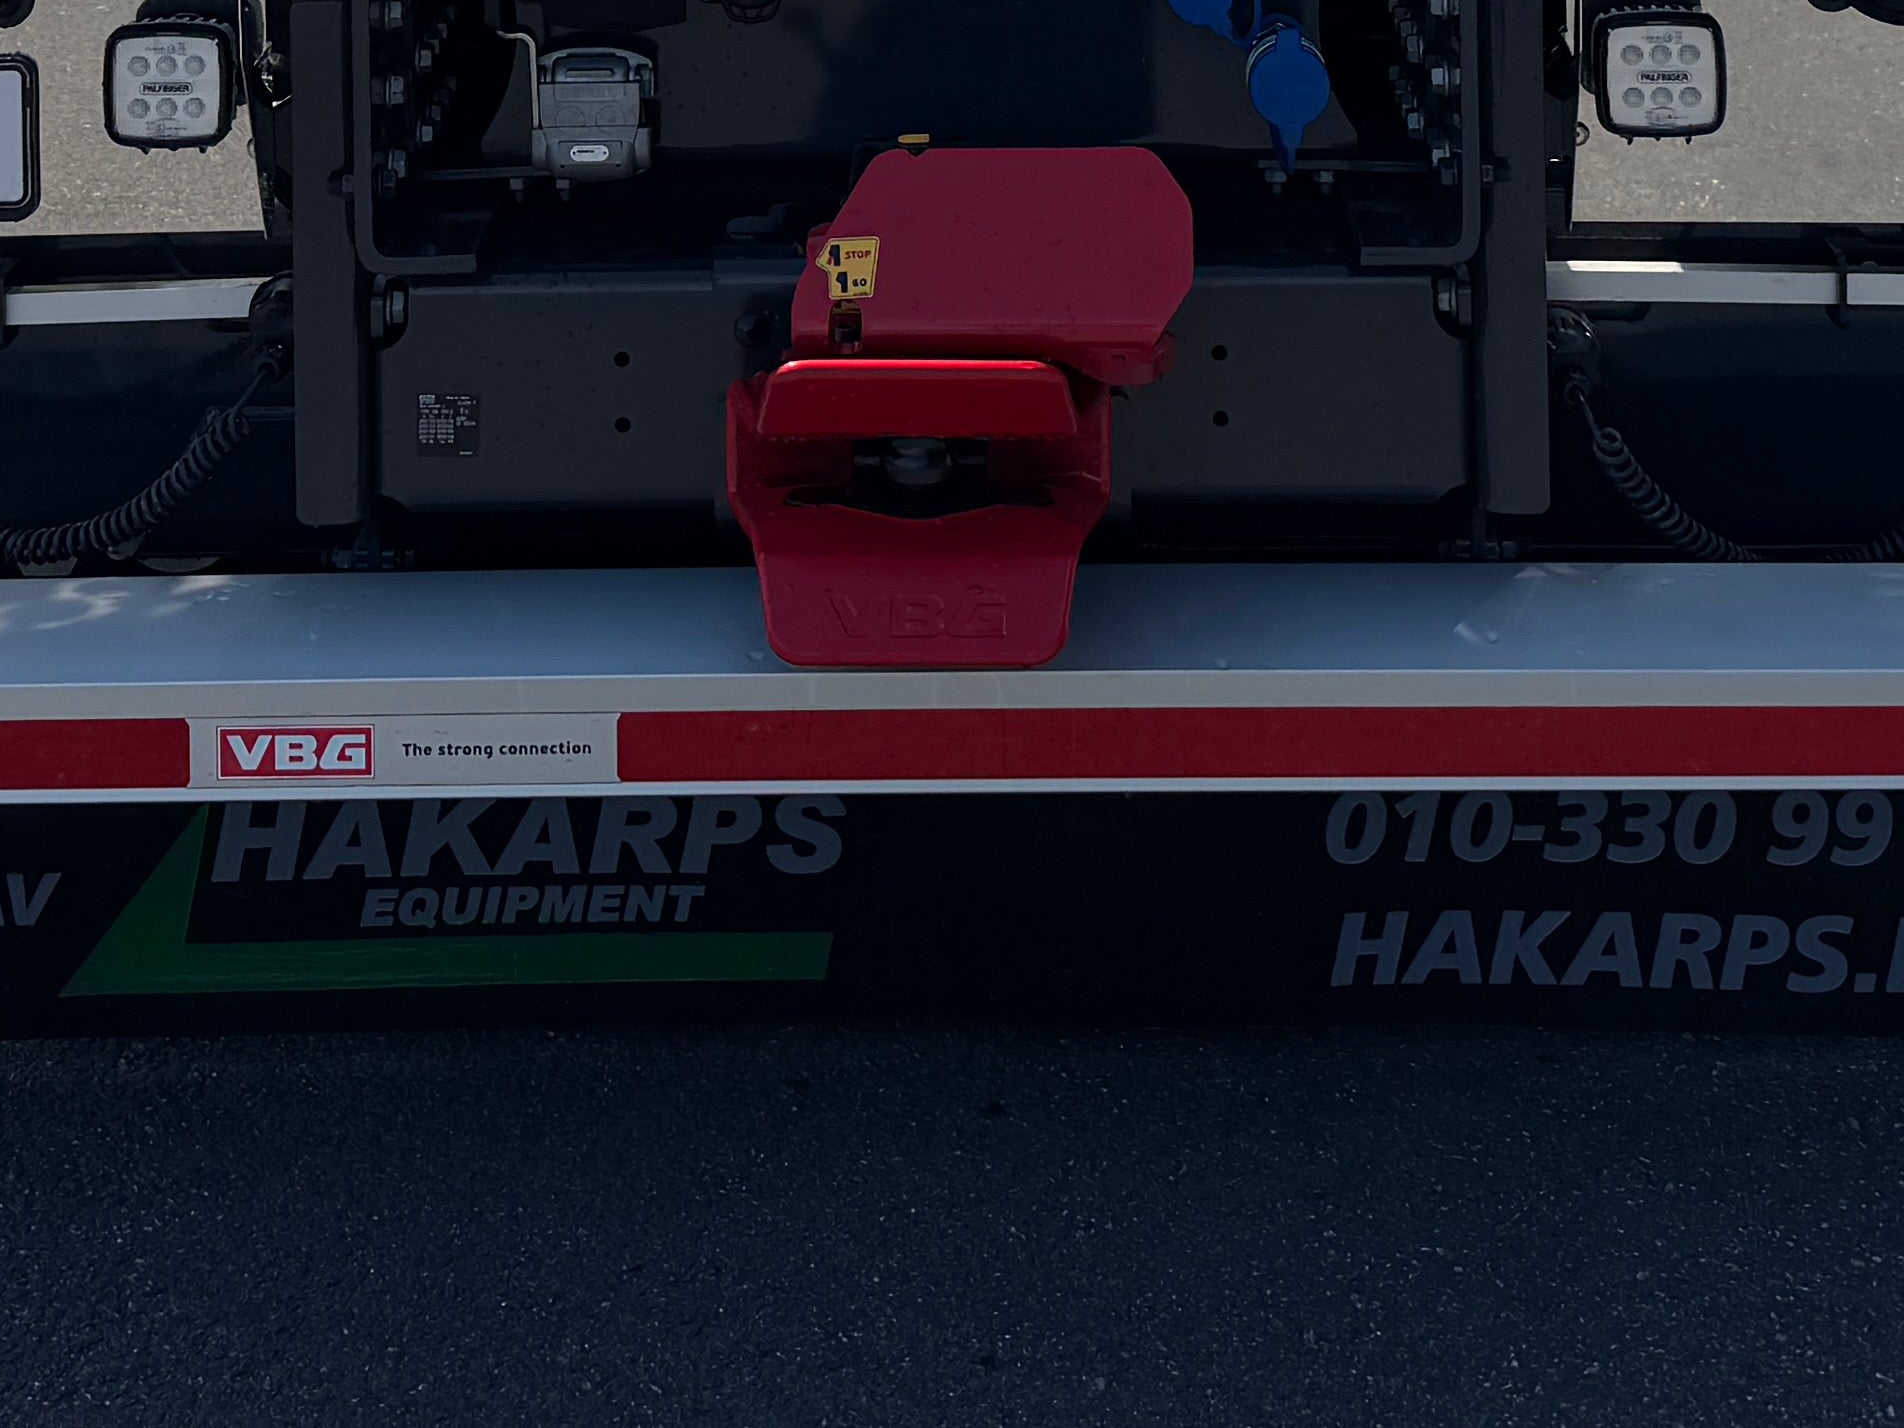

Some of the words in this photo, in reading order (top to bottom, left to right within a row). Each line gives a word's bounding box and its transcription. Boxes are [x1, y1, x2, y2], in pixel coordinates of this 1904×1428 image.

[844, 249, 872, 260] STOP
[851, 277, 867, 287] GO
[824, 593, 1007, 639] VBG
[225, 733, 367, 771] VBG
[402, 743, 432, 757] The
[437, 743, 493, 760] strong
[498, 740, 592, 756] connection
[210, 796, 848, 883] HAKARPS
[1325, 792, 1739, 866] 010-330
[1765, 792, 1895, 867] 99
[359, 883, 706, 930] EQUIPMENT
